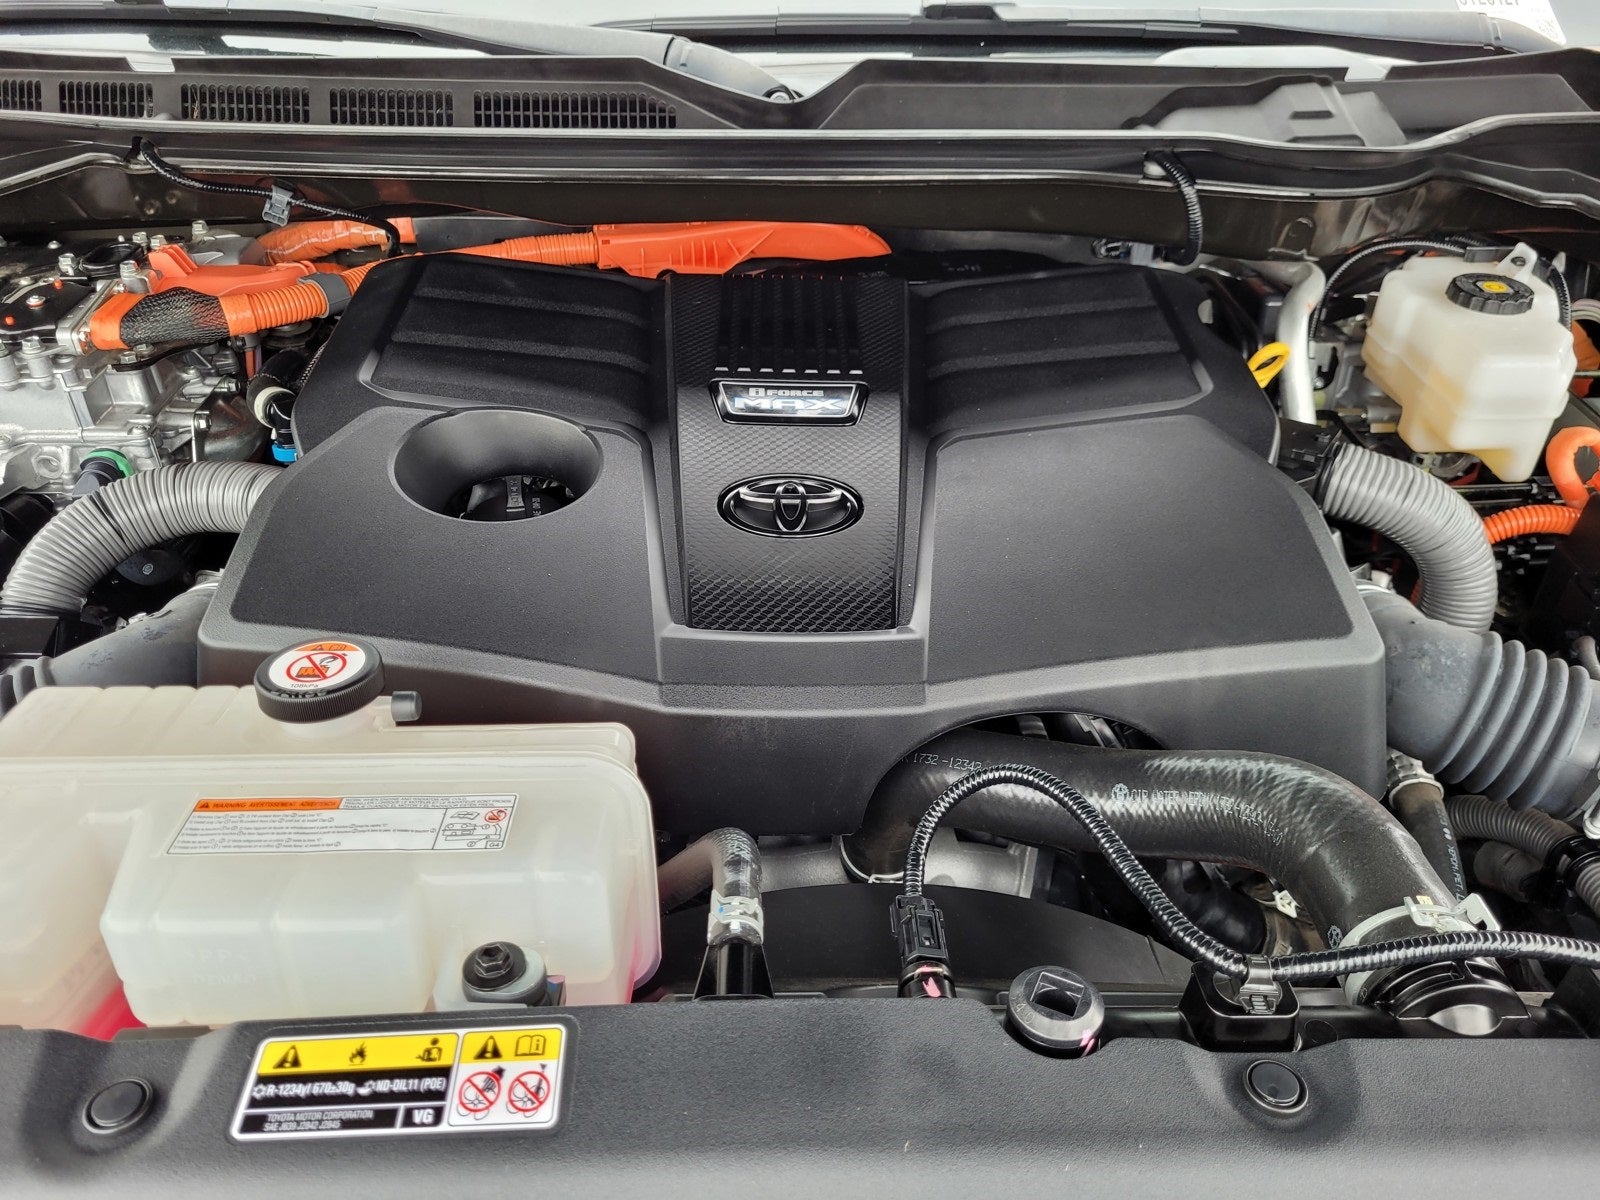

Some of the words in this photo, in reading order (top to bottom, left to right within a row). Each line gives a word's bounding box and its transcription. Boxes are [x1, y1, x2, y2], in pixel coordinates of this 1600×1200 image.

[766, 389, 824, 397] FORCE
[734, 397, 843, 410] MAX
[420, 1077, 447, 1092] (POE)
[267, 1113, 295, 1121] TOYOTA
[295, 1111, 322, 1121] MOTOR
[322, 1110, 374, 1120] CORPORATION
[412, 1108, 435, 1124] VG
